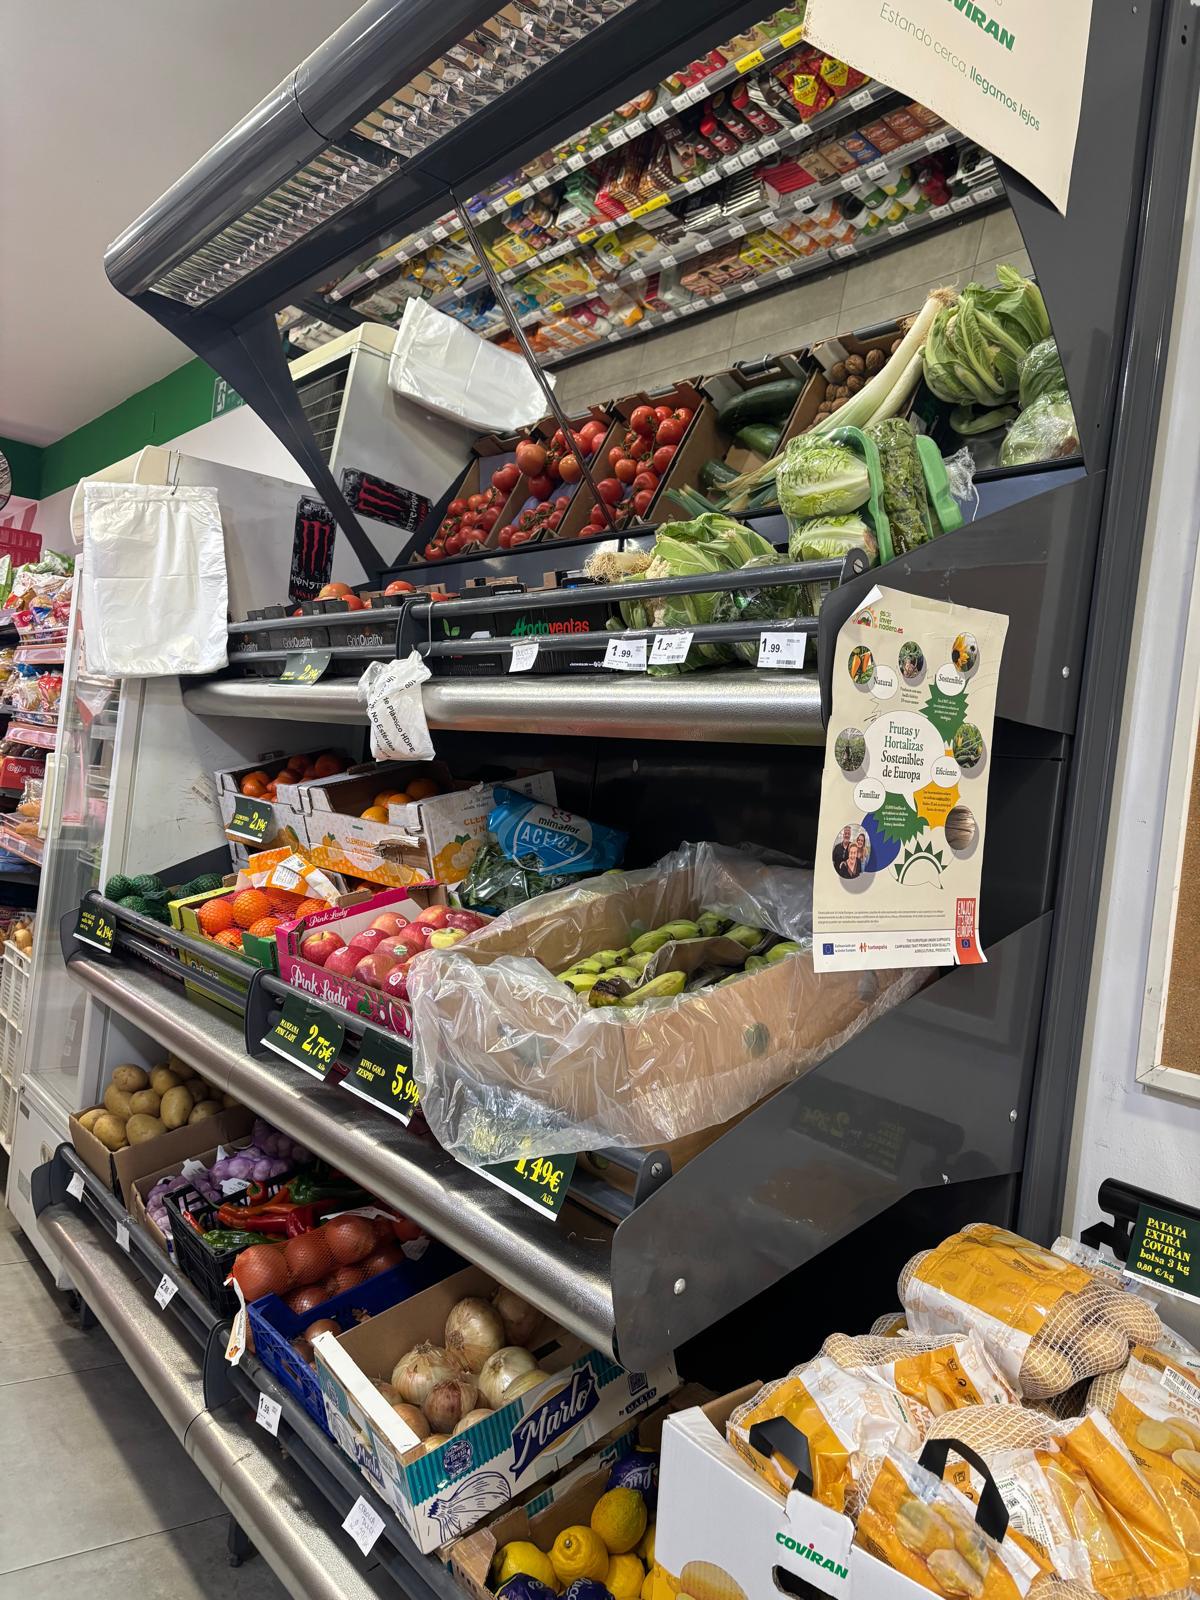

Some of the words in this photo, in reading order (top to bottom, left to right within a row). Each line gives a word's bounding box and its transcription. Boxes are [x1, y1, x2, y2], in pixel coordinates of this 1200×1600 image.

[880, 2, 932, 47] Estando
[933, 41, 969, 78] cerca,
[969, 65, 1017, 112] llegamos
[1018, 103, 1041, 131] lejos
[290, 575, 331, 591] MONSTE
[346, 633, 384, 647] GoldQuality
[873, 676, 893, 687] Natural
[938, 673, 964, 685] Sostenible
[371, 711, 379, 724] No
[889, 721, 913, 736] Frutas
[913, 728, 921, 739] y
[400, 731, 416, 753] HDPE
[884, 735, 924, 752] Hortalizas
[880, 750, 925, 767] Sostenibles
[882, 765, 893, 778] de
[893, 766, 921, 783] Europa
[935, 767, 958, 777] Eficiente
[859, 789, 881, 799] Familiar
[538, 816, 581, 836] mimaflor
[308, 913, 329, 926] Pink
[330, 908, 350, 920] Lady
[290, 964, 319, 996] Pink
[319, 979, 349, 1010] Lady
[301, 1024, 336, 1063] 2,75€
[371, 1064, 386, 1078] GOLD
[514, 1145, 565, 1194] 1,49€
[1144, 1227, 1182, 1249] EXTRA
[1146, 1217, 1188, 1239] PATATA
[1142, 1238, 1192, 1262] COVIRAN
[1136, 1261, 1153, 1274] 0,80
[1153, 1267, 1175, 1284] €/kg
[1139, 1248, 1165, 1266] bolsa
[1167, 1258, 1175, 1269] 3
[1176, 1262, 1190, 1277] kg
[627, 1388, 657, 1412] MARLO
[510, 1375, 594, 1471] Marlo
[775, 1532, 849, 1580] COVIRAN
